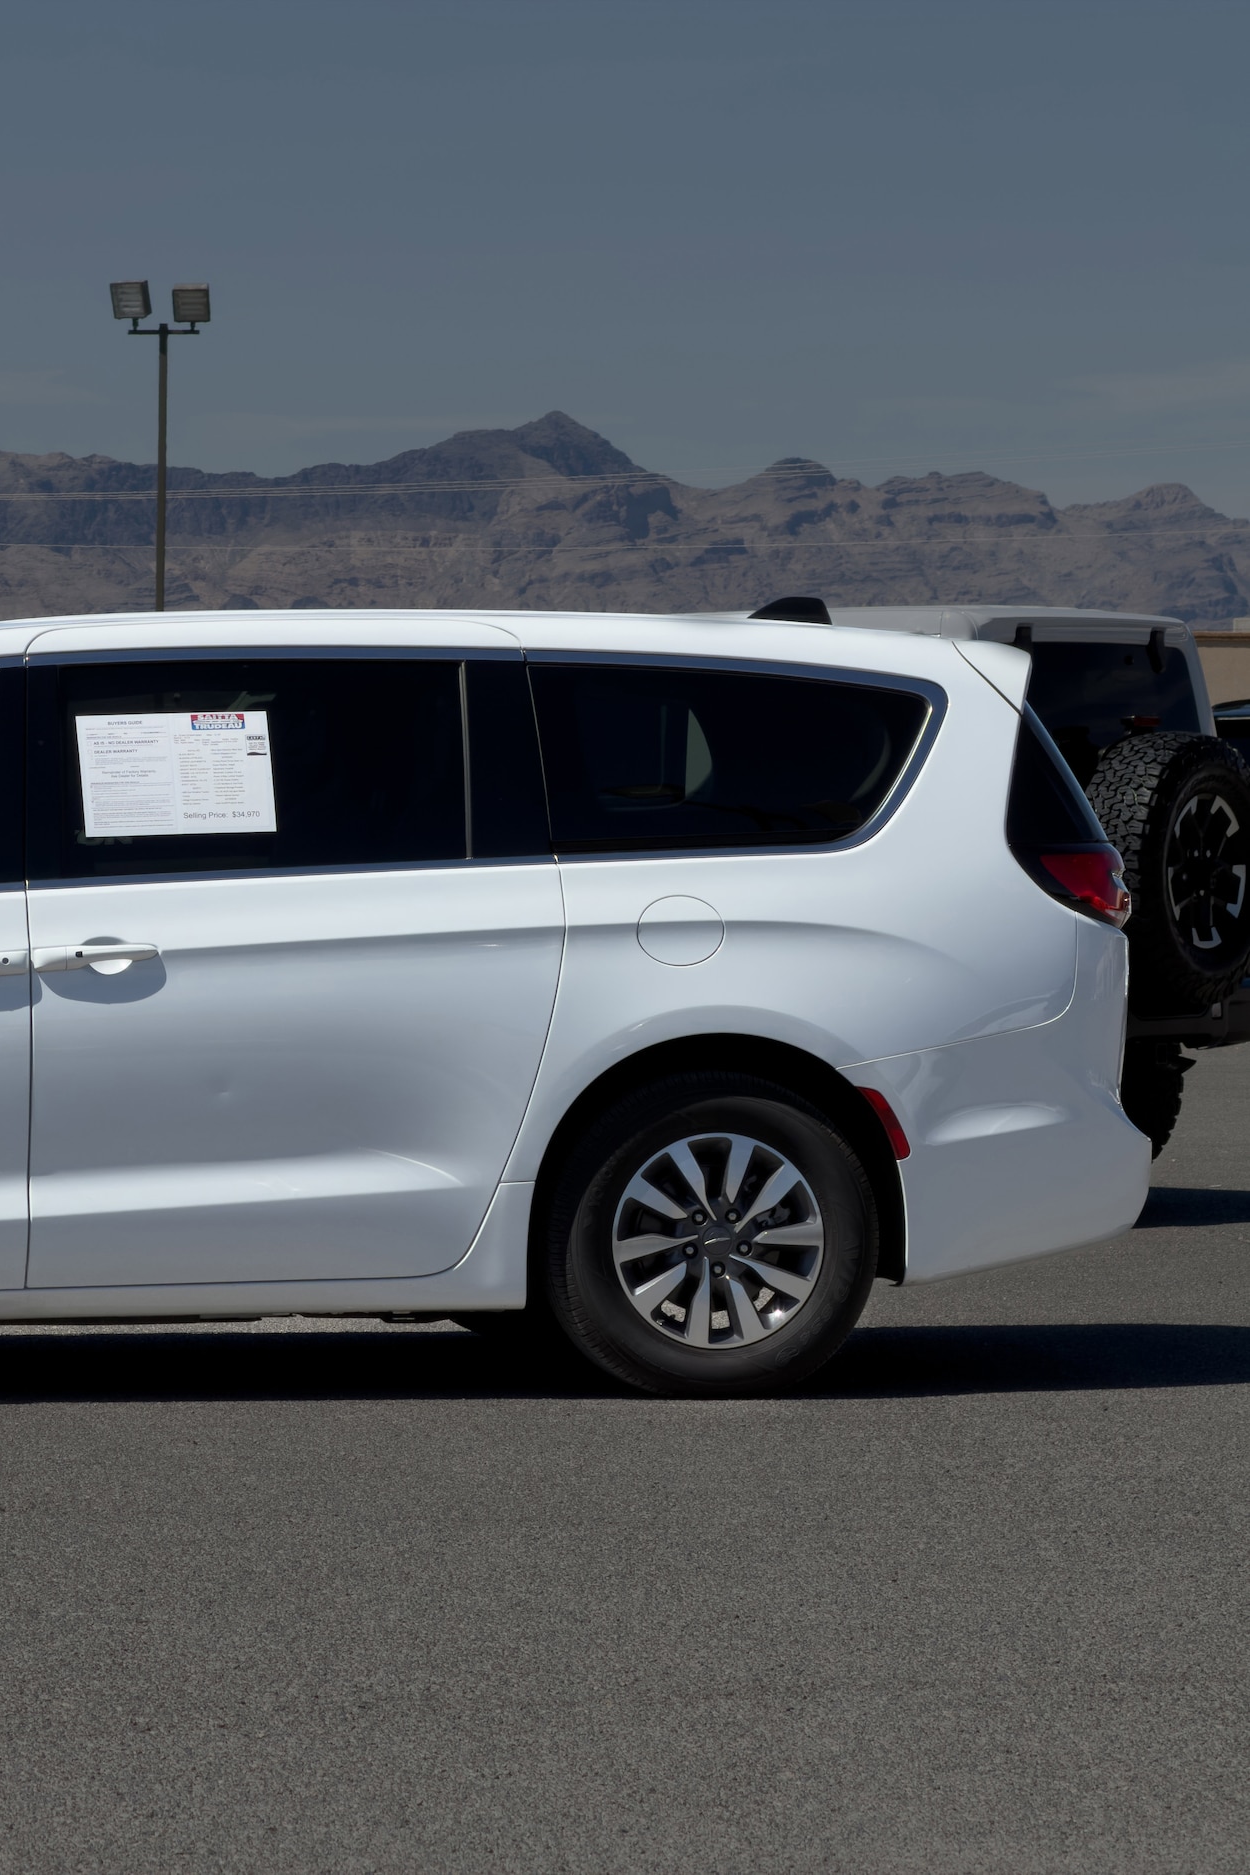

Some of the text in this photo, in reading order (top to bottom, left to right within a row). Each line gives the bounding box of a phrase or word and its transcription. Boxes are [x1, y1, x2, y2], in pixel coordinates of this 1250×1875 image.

[193, 722, 242, 730] TRUDEAU
[183, 811, 207, 820] Selling
[208, 811, 229, 819] Price:
[231, 810, 261, 819] $34,970
